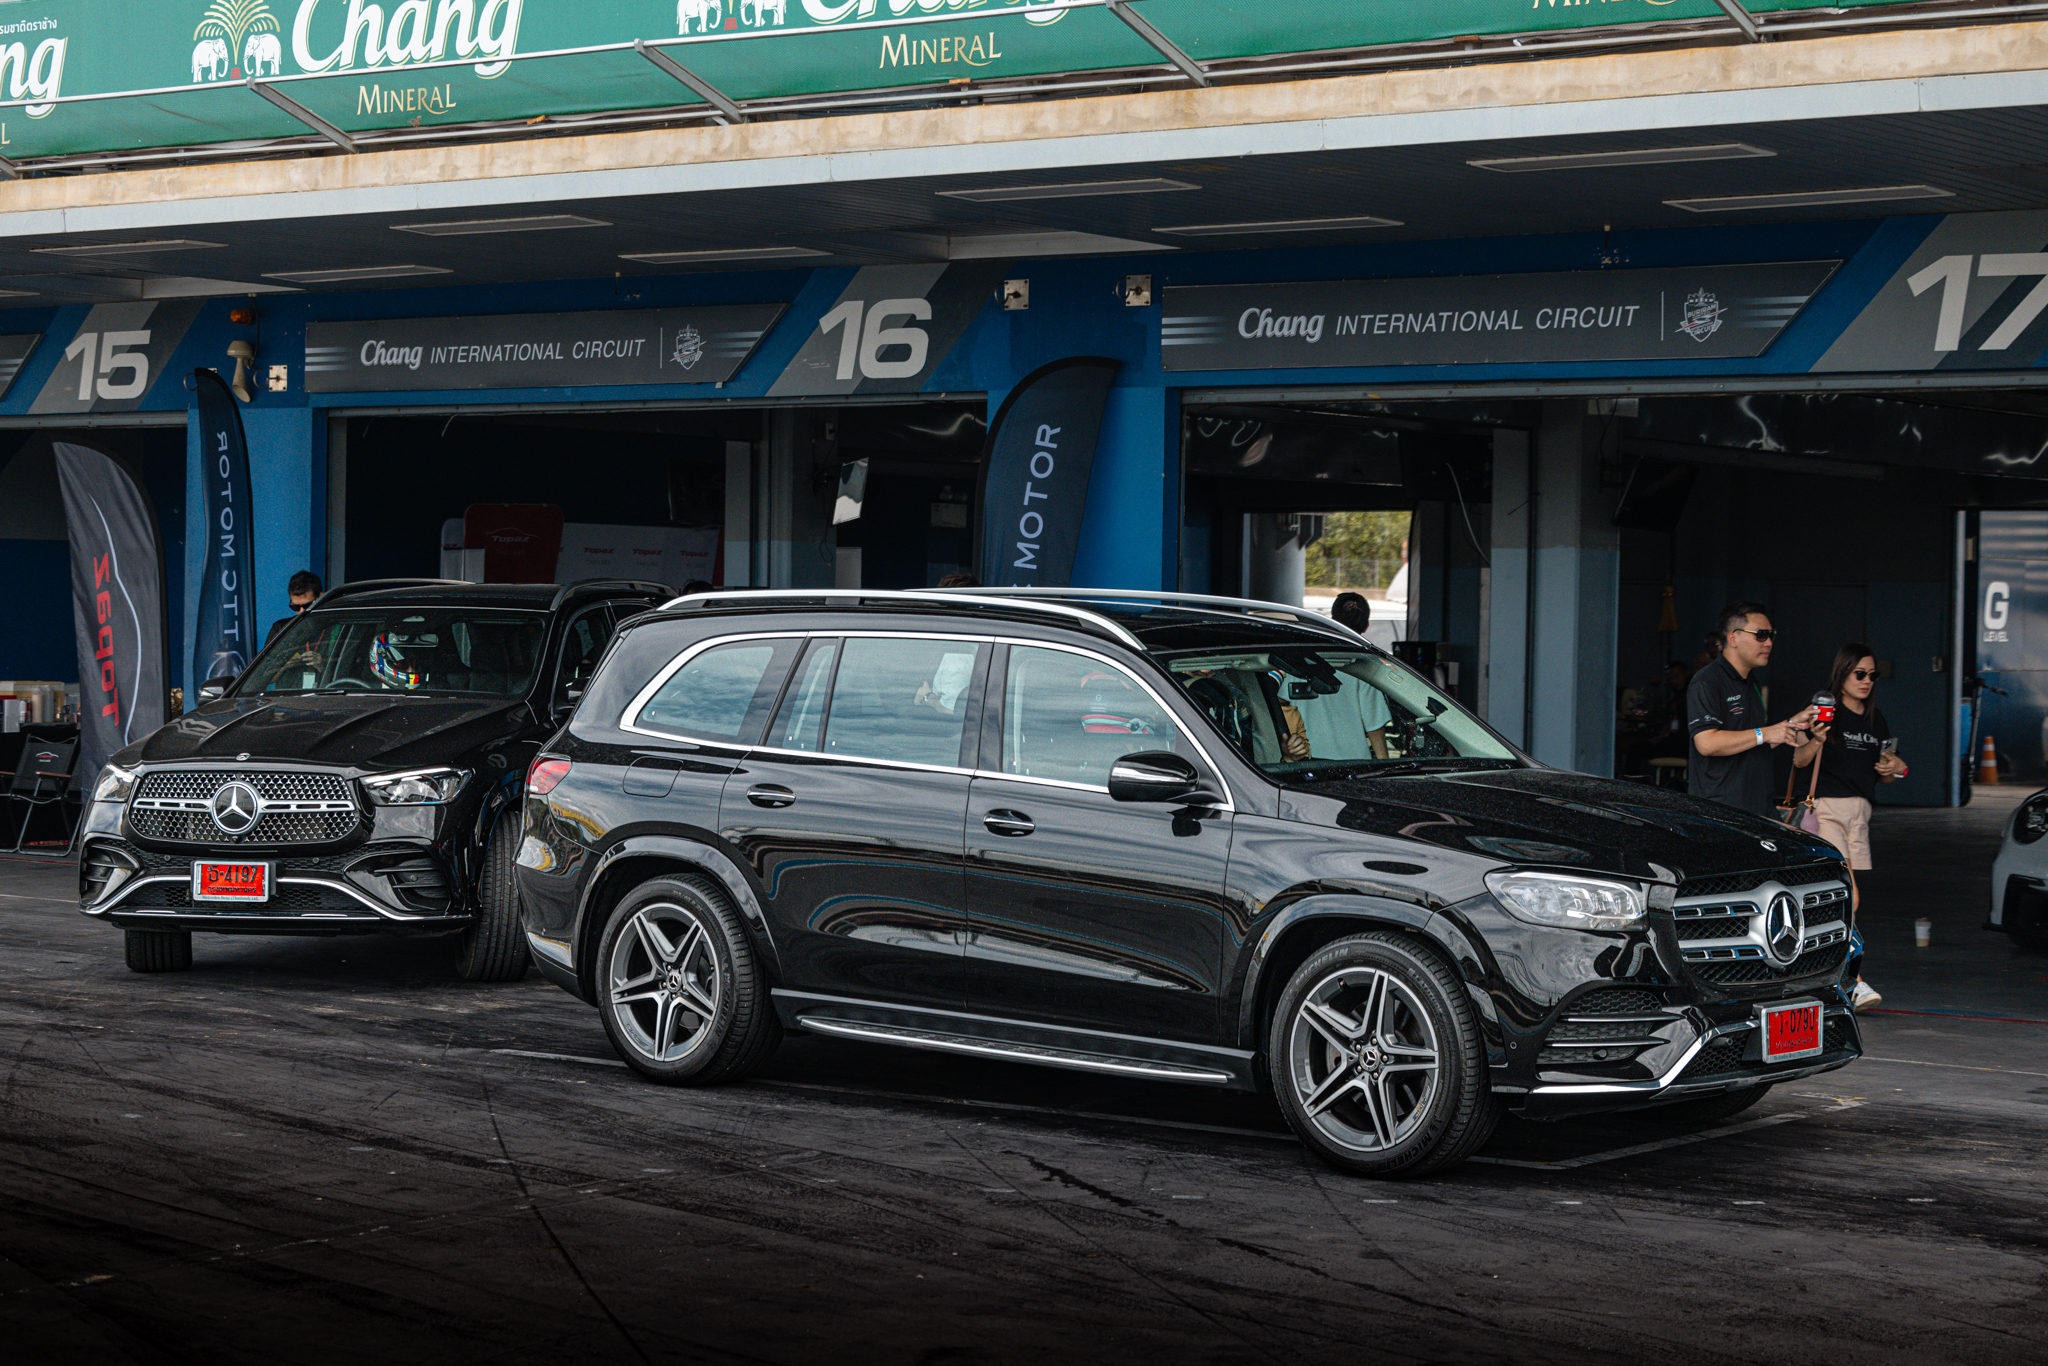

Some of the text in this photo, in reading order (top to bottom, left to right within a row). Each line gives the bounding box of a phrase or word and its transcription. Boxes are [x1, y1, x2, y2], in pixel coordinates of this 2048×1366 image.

[878, 32, 1002, 69] MINERAL
[357, 84, 457, 115] MINERAL
[1907, 253, 2048, 352] 17
[819, 298, 932, 380] 16
[1238, 305, 1640, 343] Chang INTERNATIONAL CIRCUIT
[65, 329, 151, 400] 15
[360, 339, 645, 370] Chang INTERNATIONAL CIRCUIT
[1013, 423, 1062, 570] MOTOR
[583, 546, 615, 556] Topaz
[632, 548, 663, 557] Topaz
[680, 549, 709, 558] Topaz
[1983, 580, 2010, 630] G
